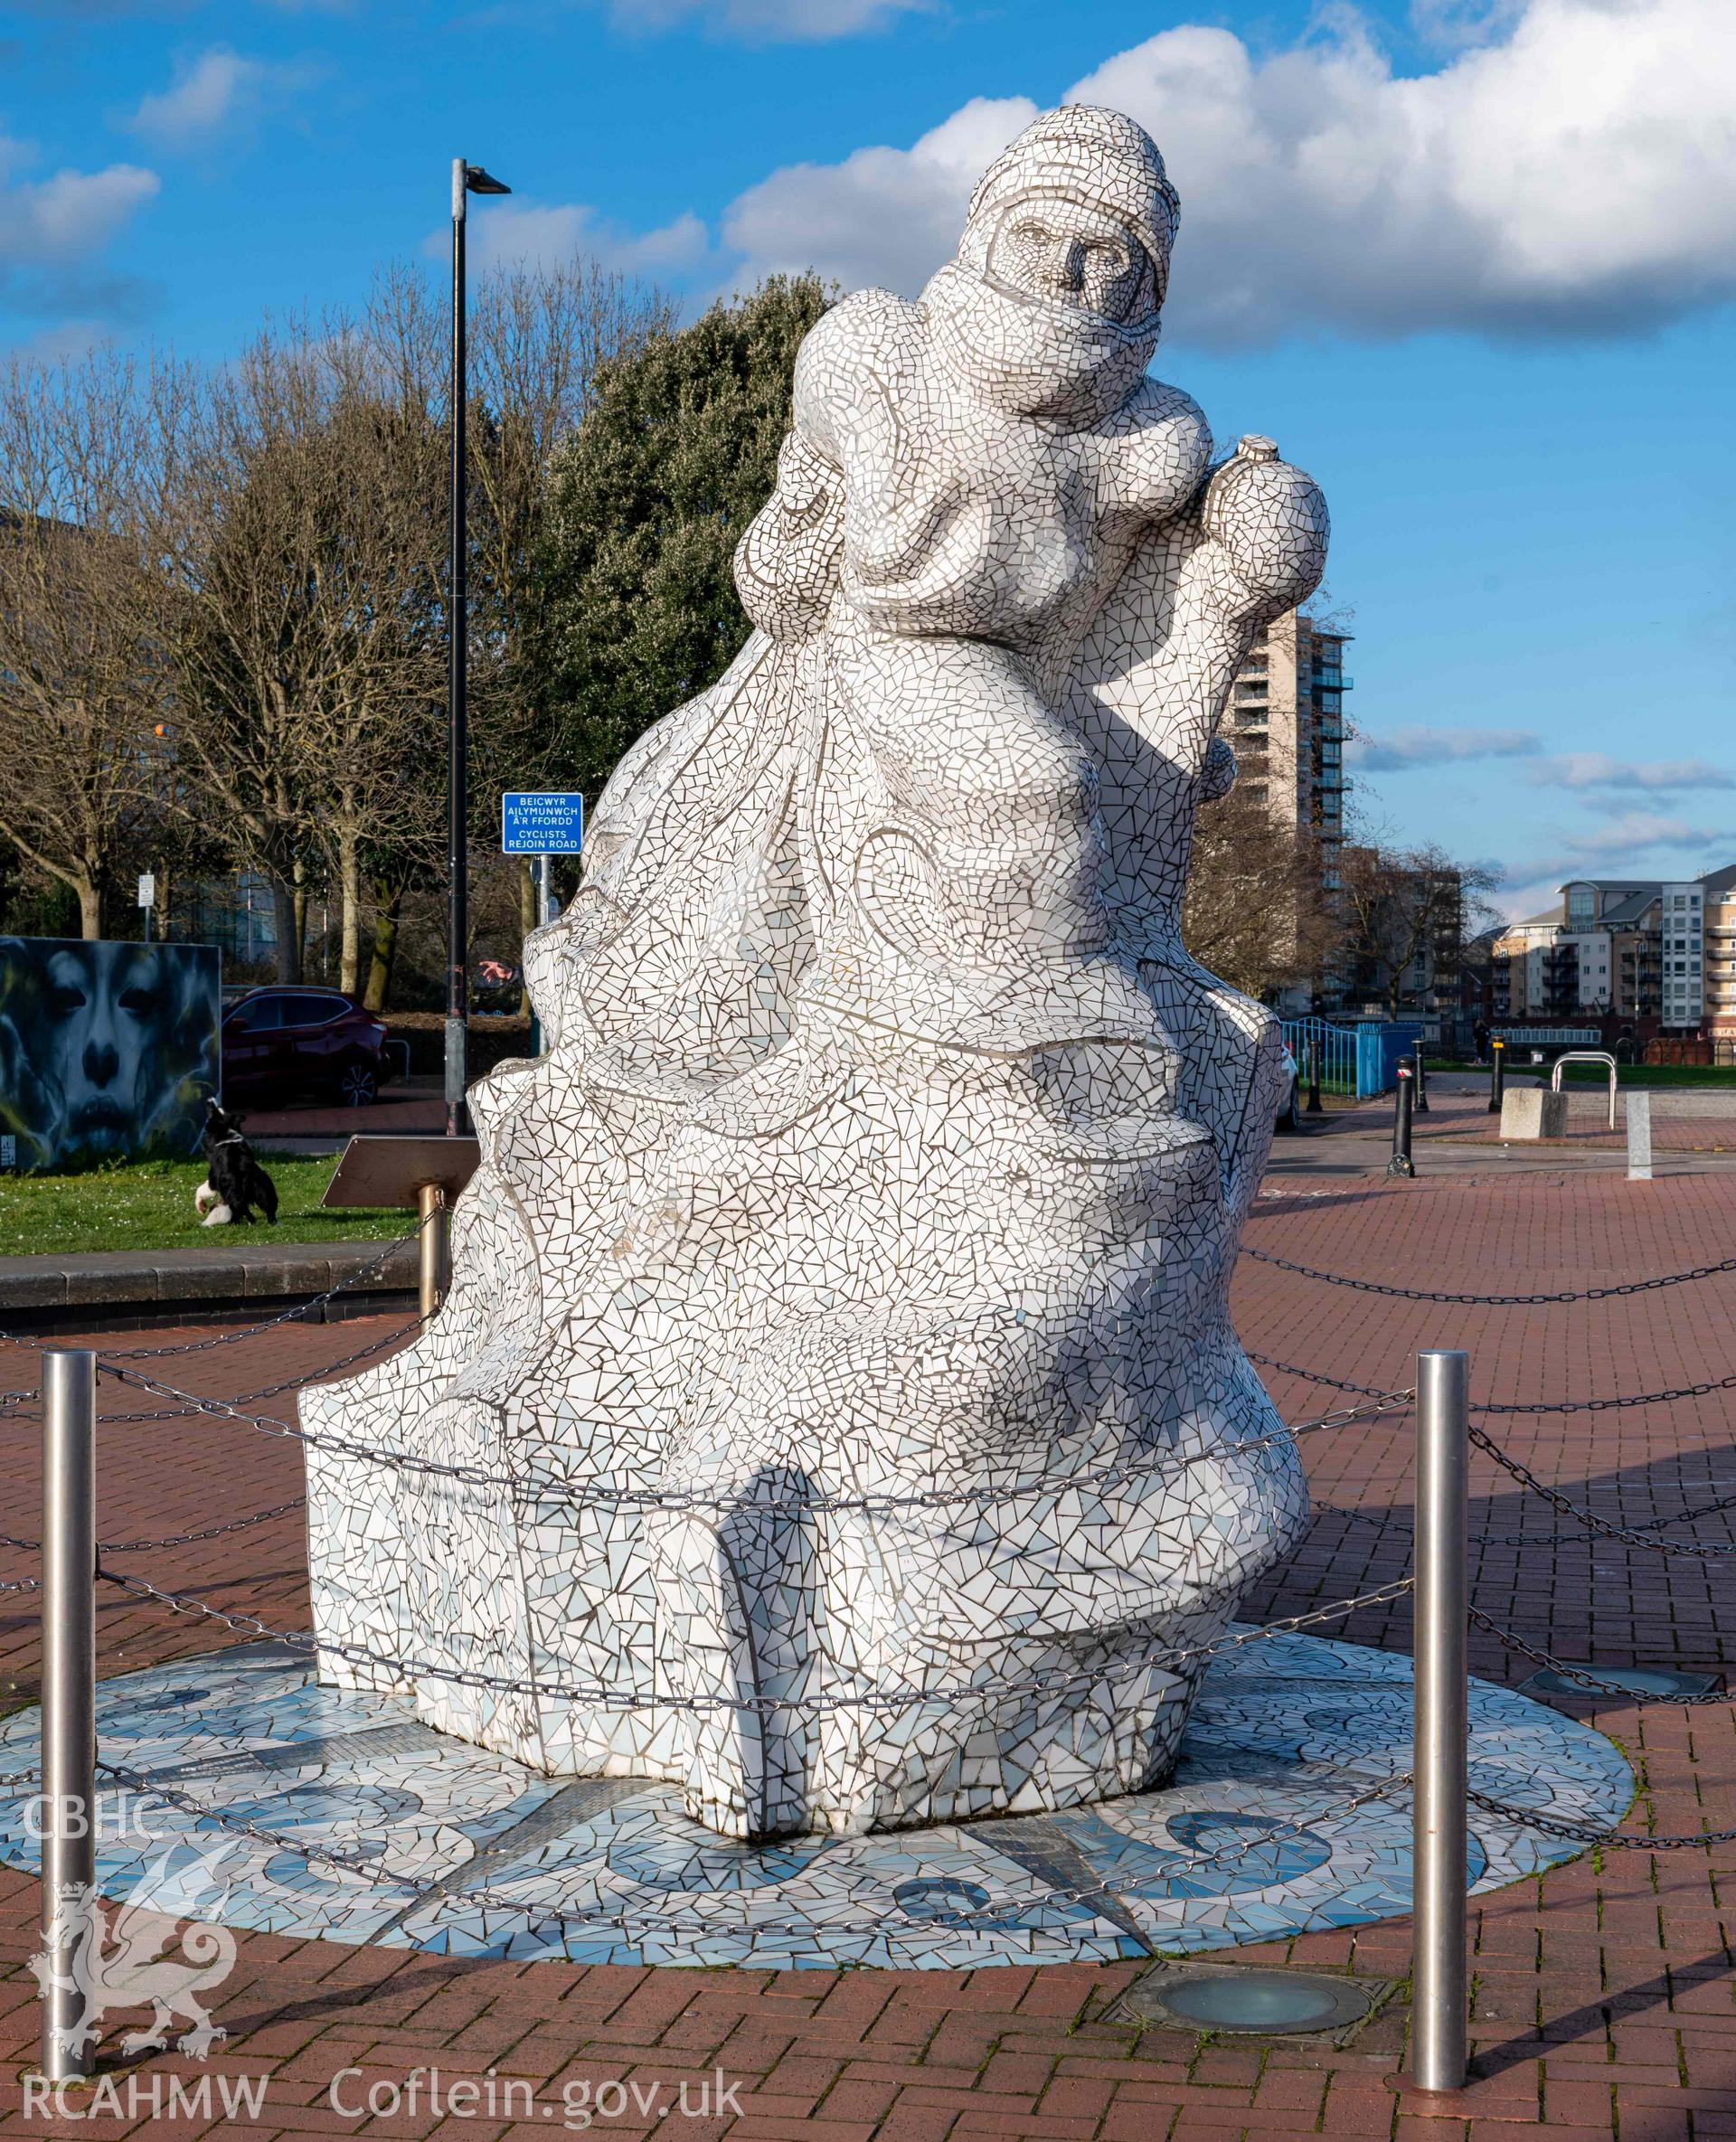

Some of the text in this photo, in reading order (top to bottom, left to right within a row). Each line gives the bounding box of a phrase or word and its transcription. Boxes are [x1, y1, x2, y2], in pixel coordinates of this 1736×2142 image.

[520, 797, 566, 806] BEICWYR
[508, 807, 578, 816] AILYMUNWCH
[532, 816, 572, 825] FFORDD
[519, 830, 567, 838] CYCLISTS
[509, 840, 578, 848] REJOIN ROAD
